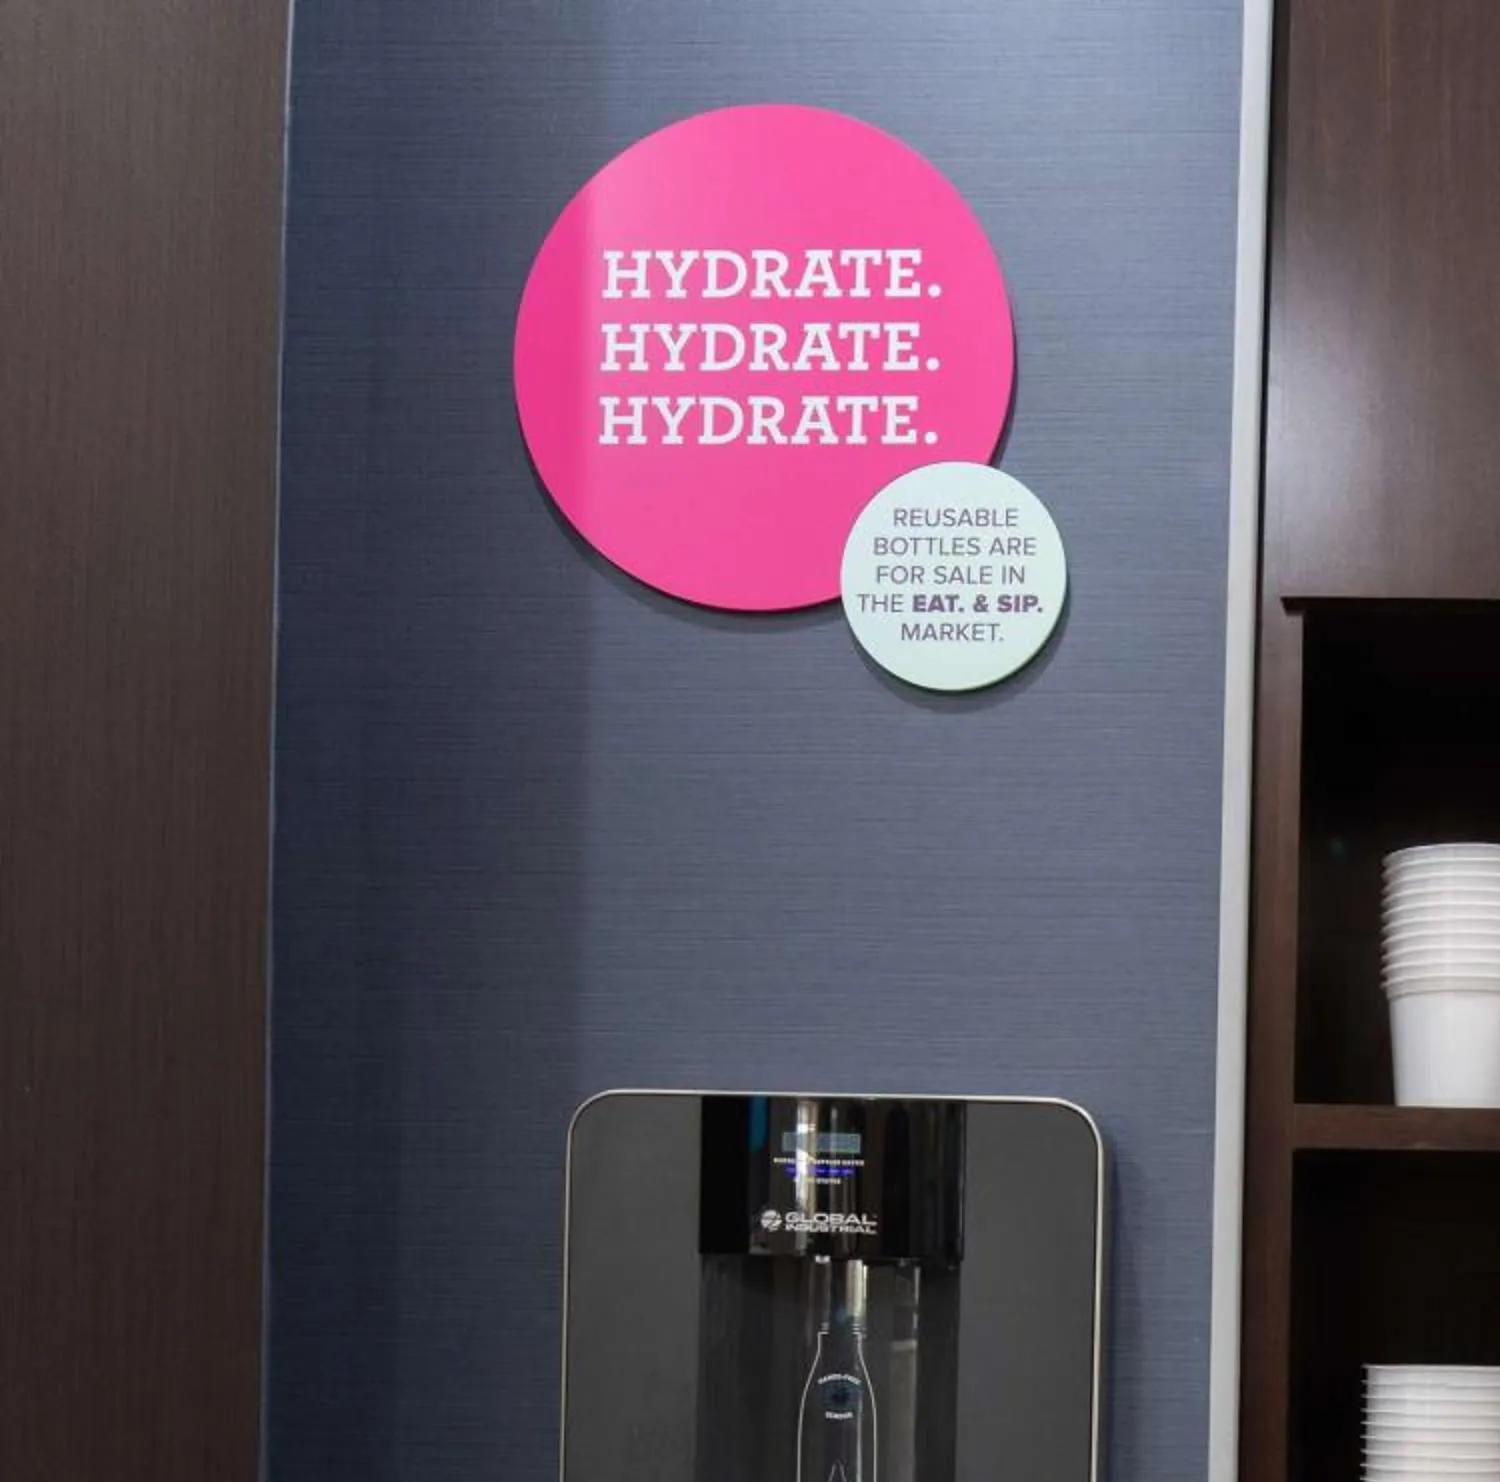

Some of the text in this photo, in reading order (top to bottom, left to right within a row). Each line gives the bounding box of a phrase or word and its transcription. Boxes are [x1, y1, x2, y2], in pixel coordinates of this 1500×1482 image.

[602, 249, 942, 298] HYDRATE.
[600, 322, 940, 372] HYDRATE.
[598, 395, 938, 445] HYDRATE.
[893, 508, 1018, 527] REUSABLE
[873, 537, 1036, 556] BOTTLES ARE
[876, 565, 1025, 584] FOR SALE IN
[857, 593, 1043, 613] THE EAT. & SIP.
[901, 623, 1004, 642] MARKET.
[784, 1211, 878, 1226] GLOBAL
